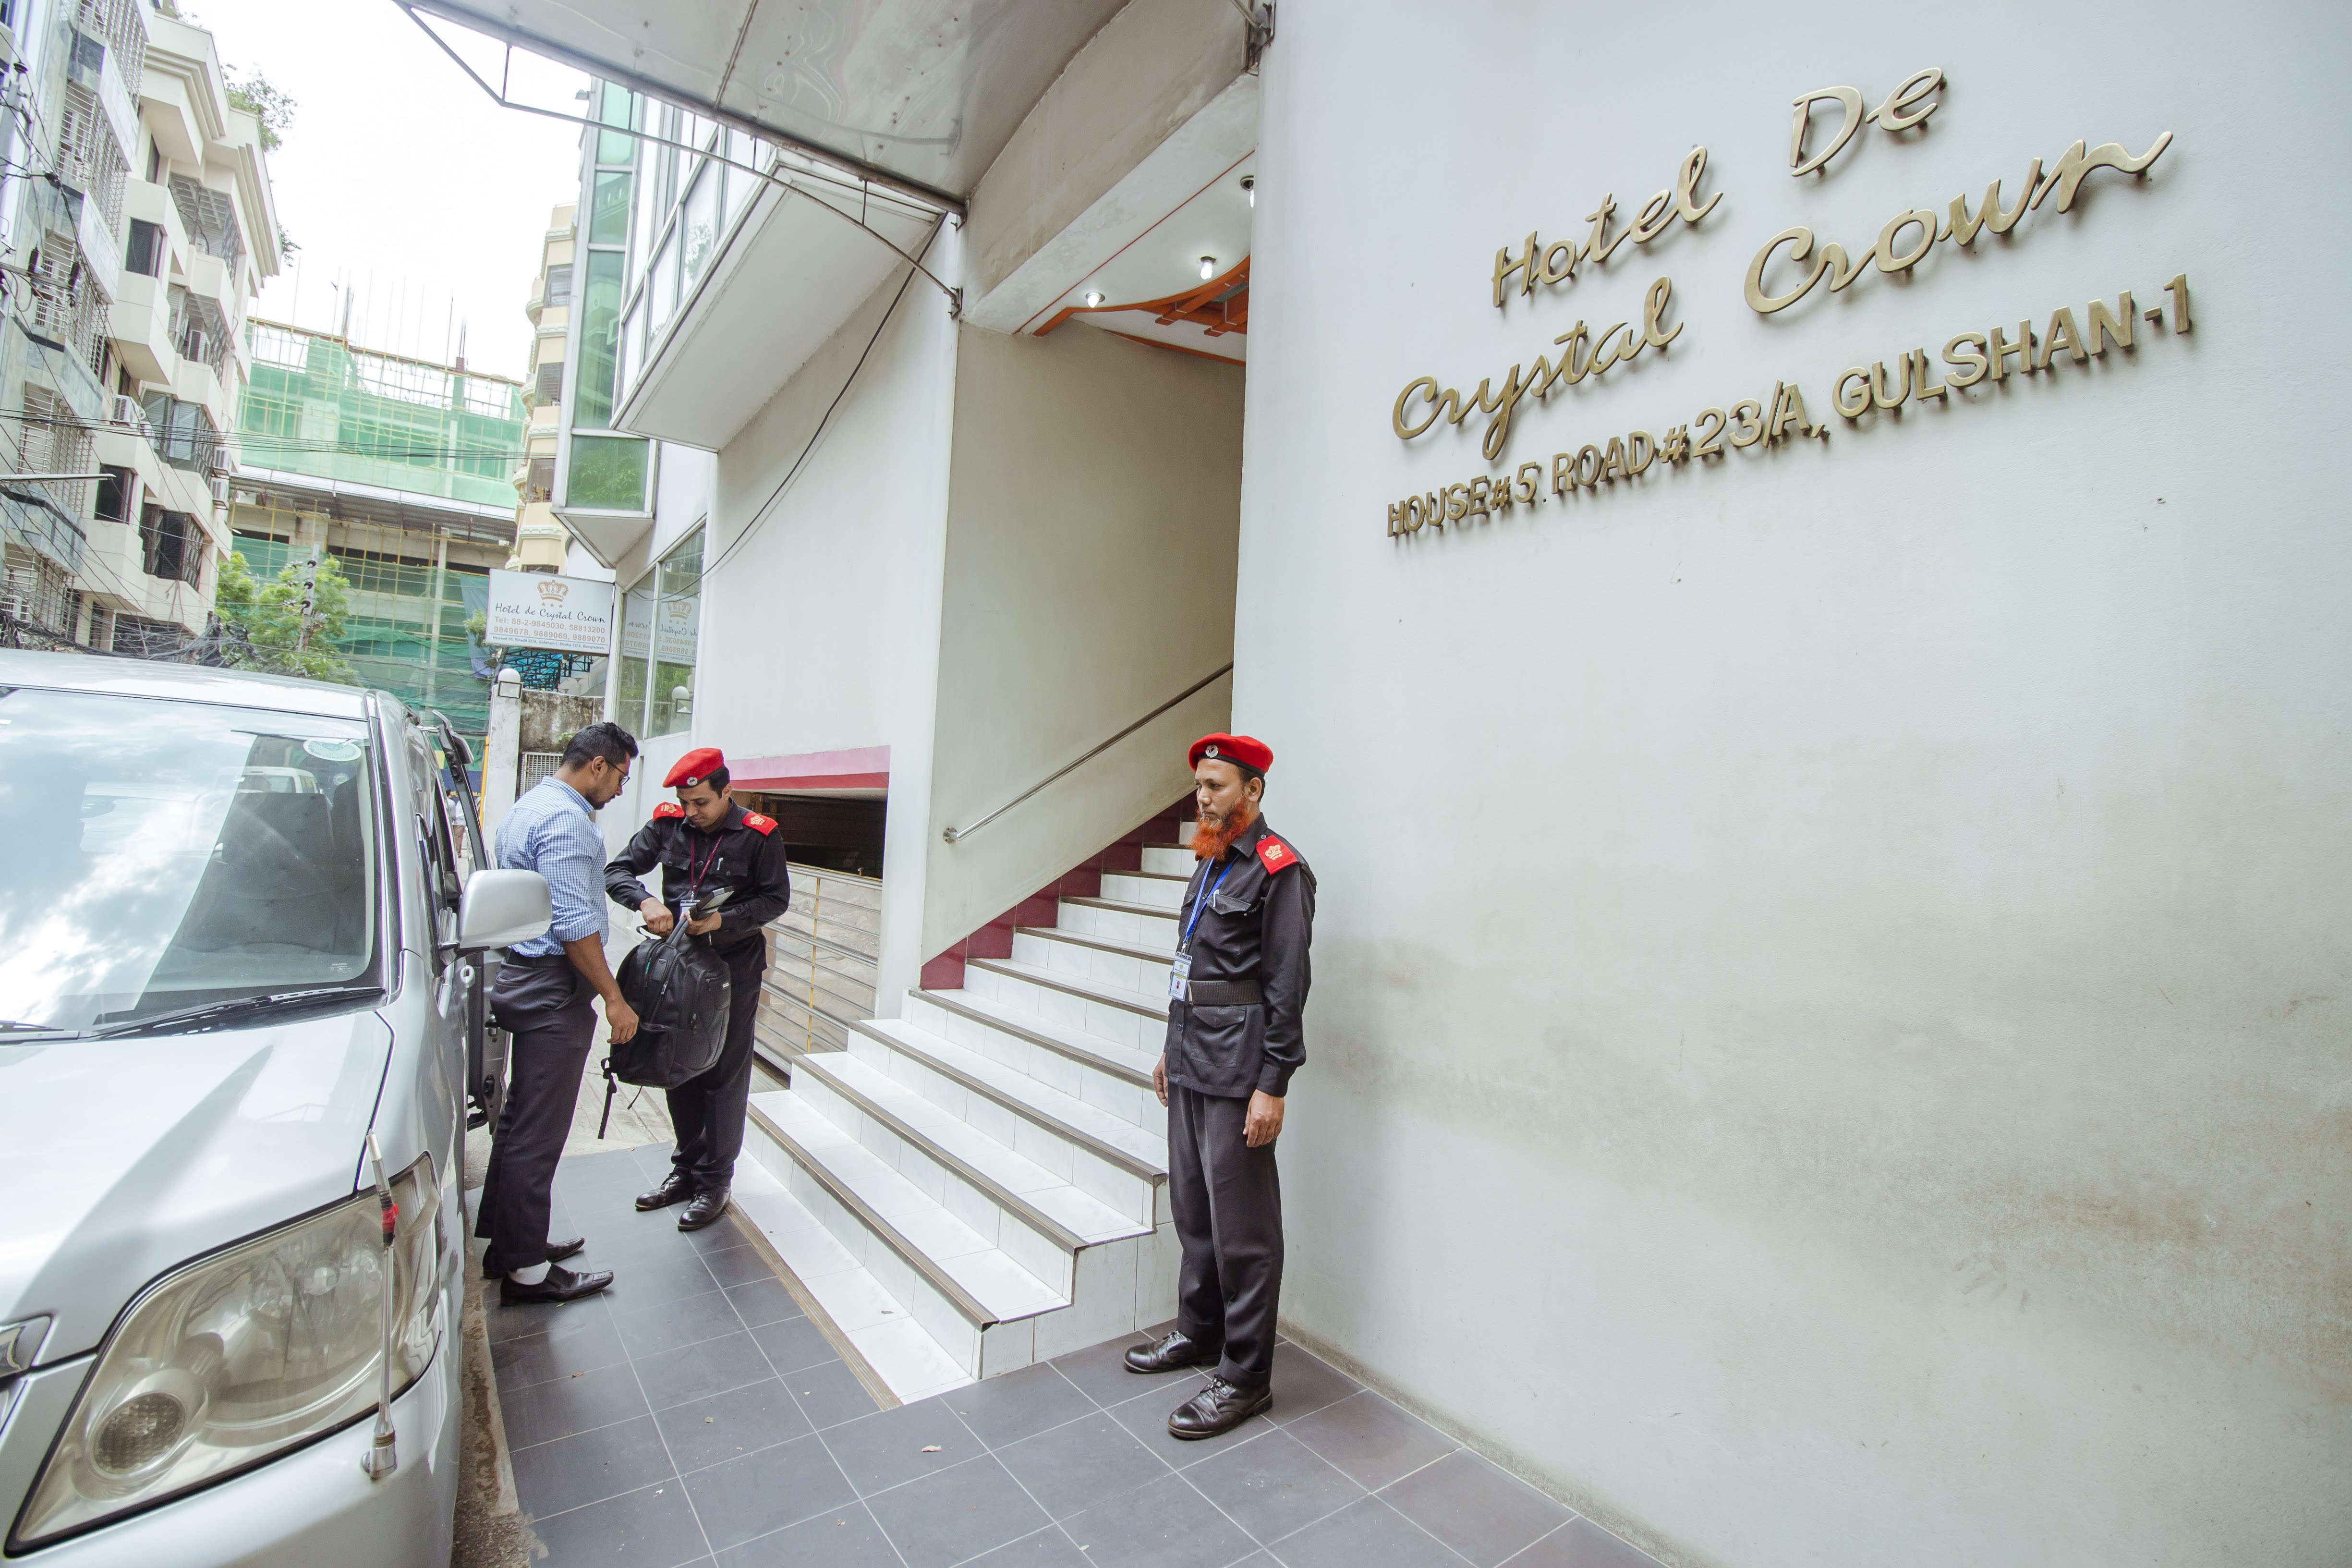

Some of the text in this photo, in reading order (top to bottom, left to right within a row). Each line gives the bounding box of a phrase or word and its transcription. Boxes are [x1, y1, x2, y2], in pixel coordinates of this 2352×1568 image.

[1492, 66, 1943, 308] Hotel De
[1392, 131, 2173, 460] Crystal Crown
[1831, 272, 2190, 418] GULSHAN-1
[494, 626, 605, 643] 9849678, 9889069, 9889070
[495, 603, 606, 623] Hotel de Crystal Crown
[512, 618, 566, 630] 88-2-9845030,
[569, 624, 605, 634] 58813200
